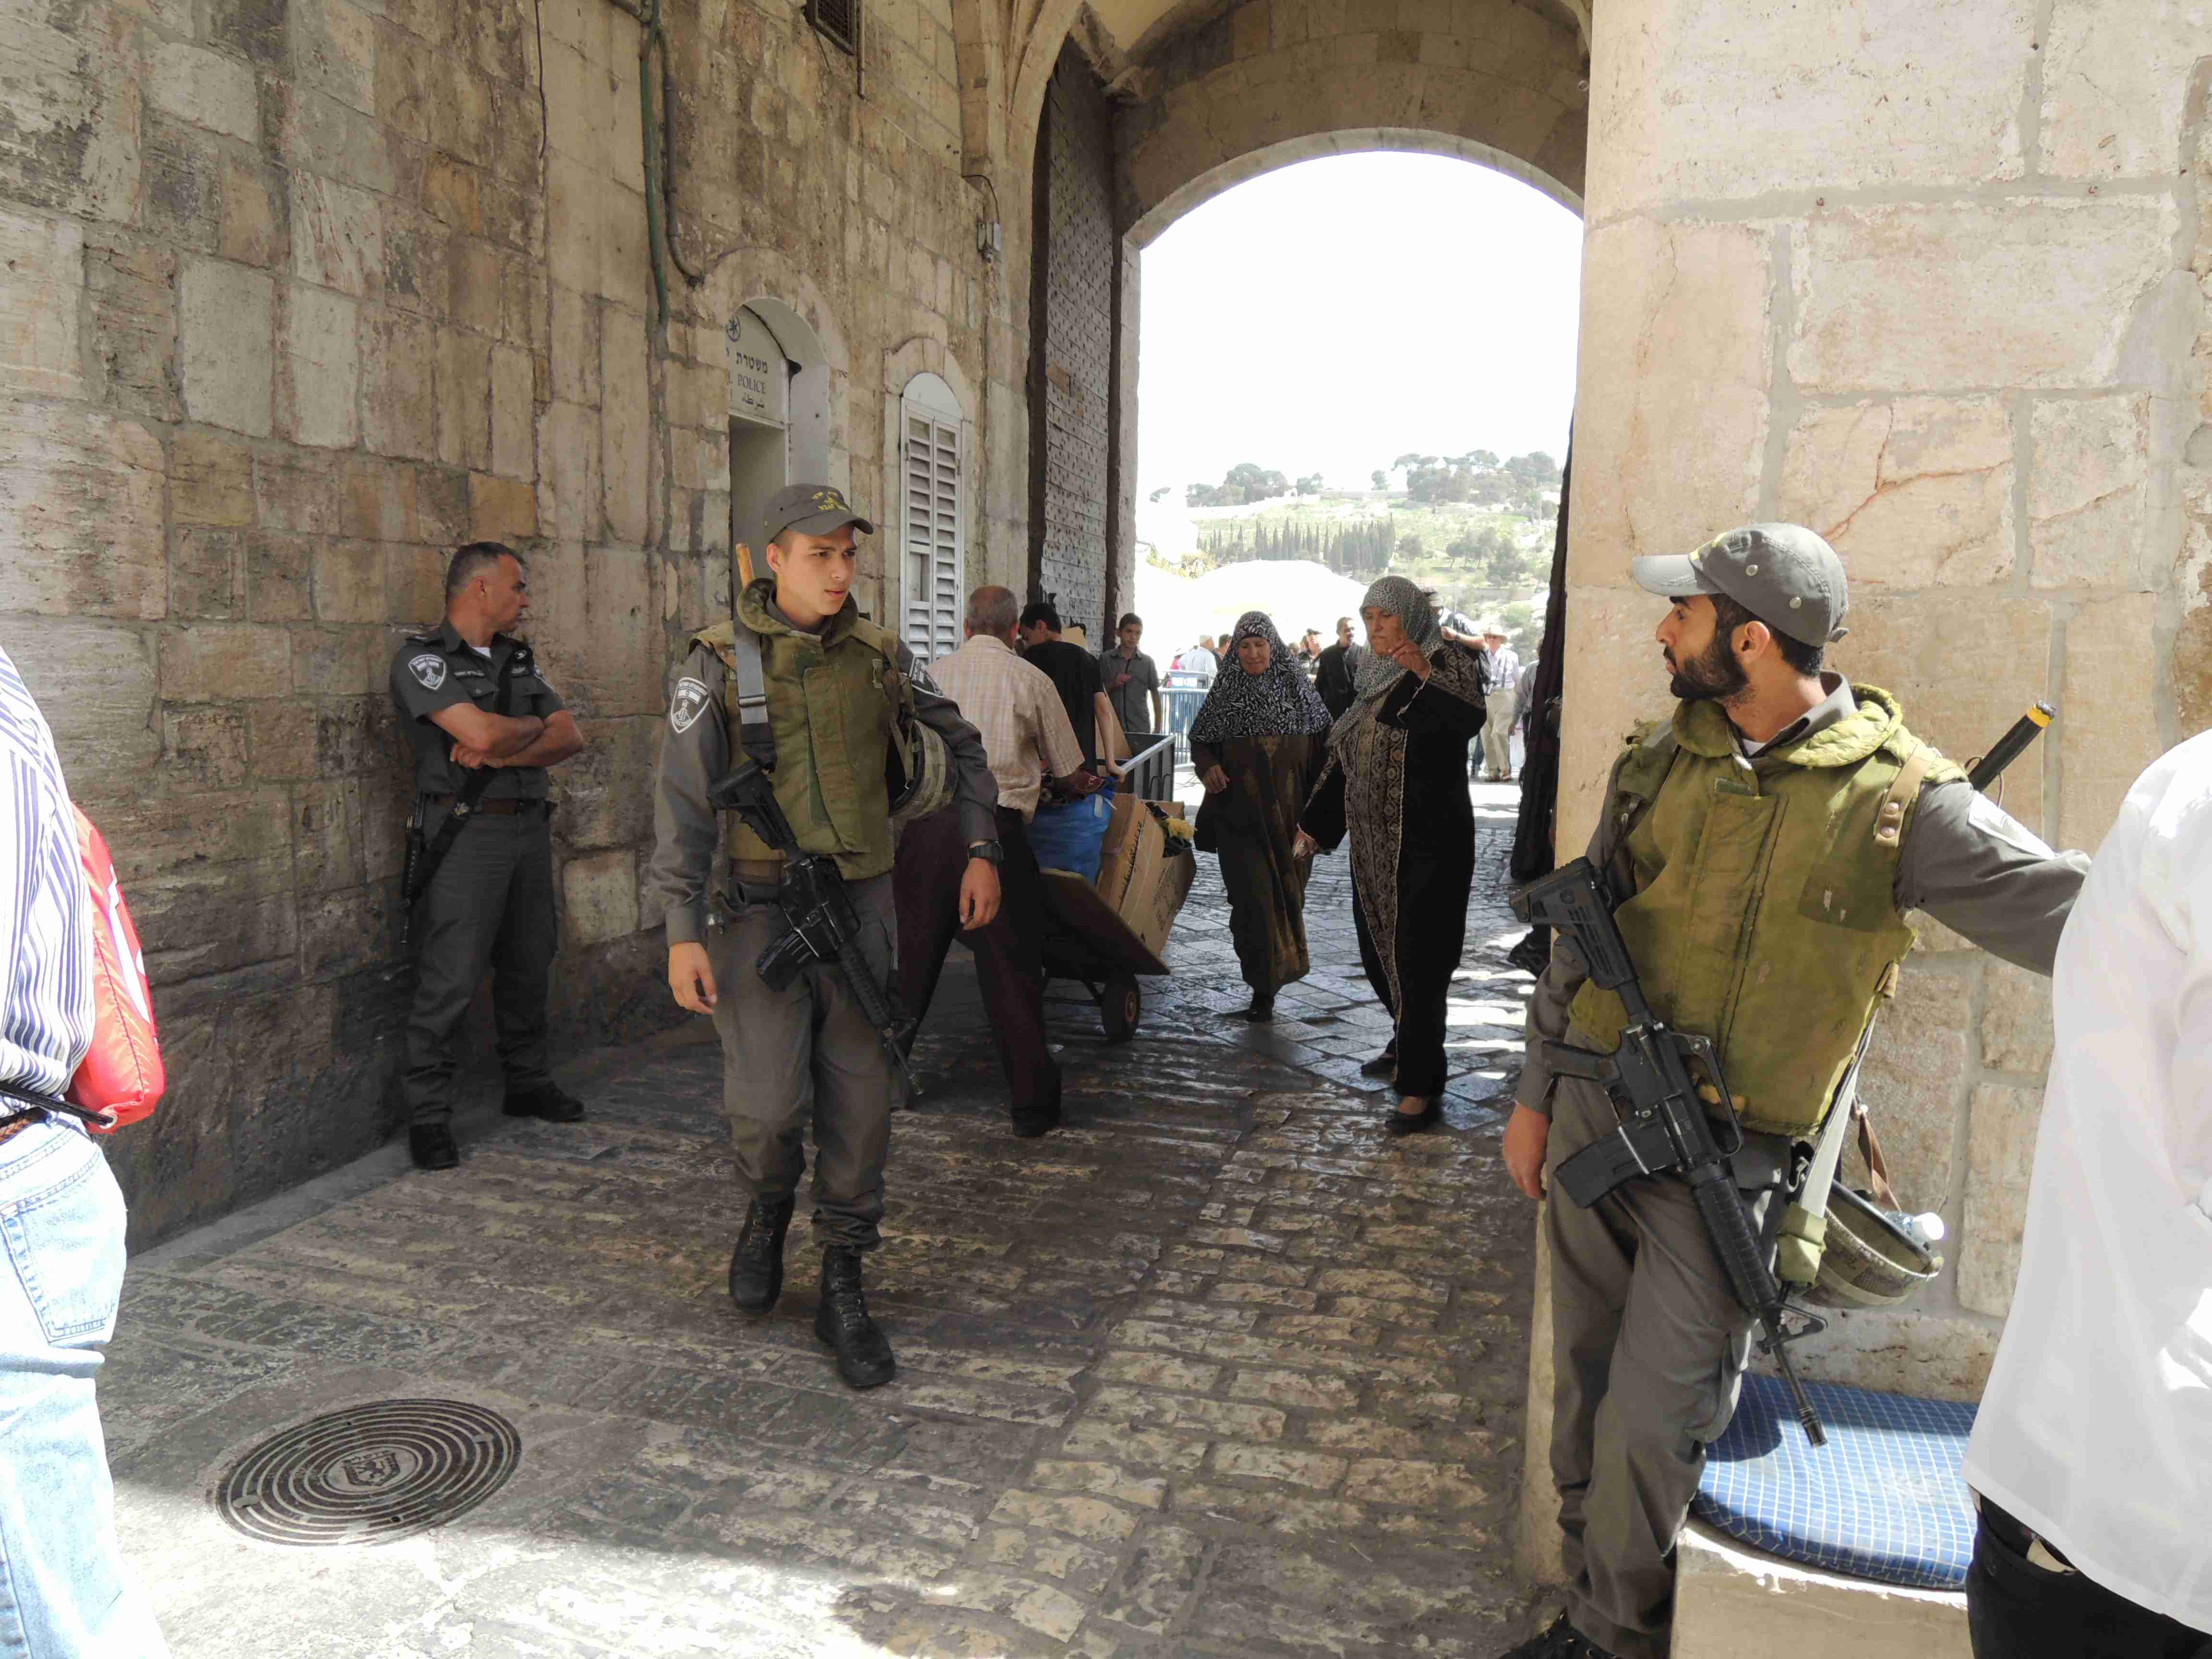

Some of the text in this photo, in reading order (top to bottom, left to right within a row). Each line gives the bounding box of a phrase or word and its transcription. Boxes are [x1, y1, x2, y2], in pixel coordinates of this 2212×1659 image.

[736, 351, 768, 373] משטרת
[737, 373, 767, 394] POLICE
[742, 392, 764, 410] شرطة
